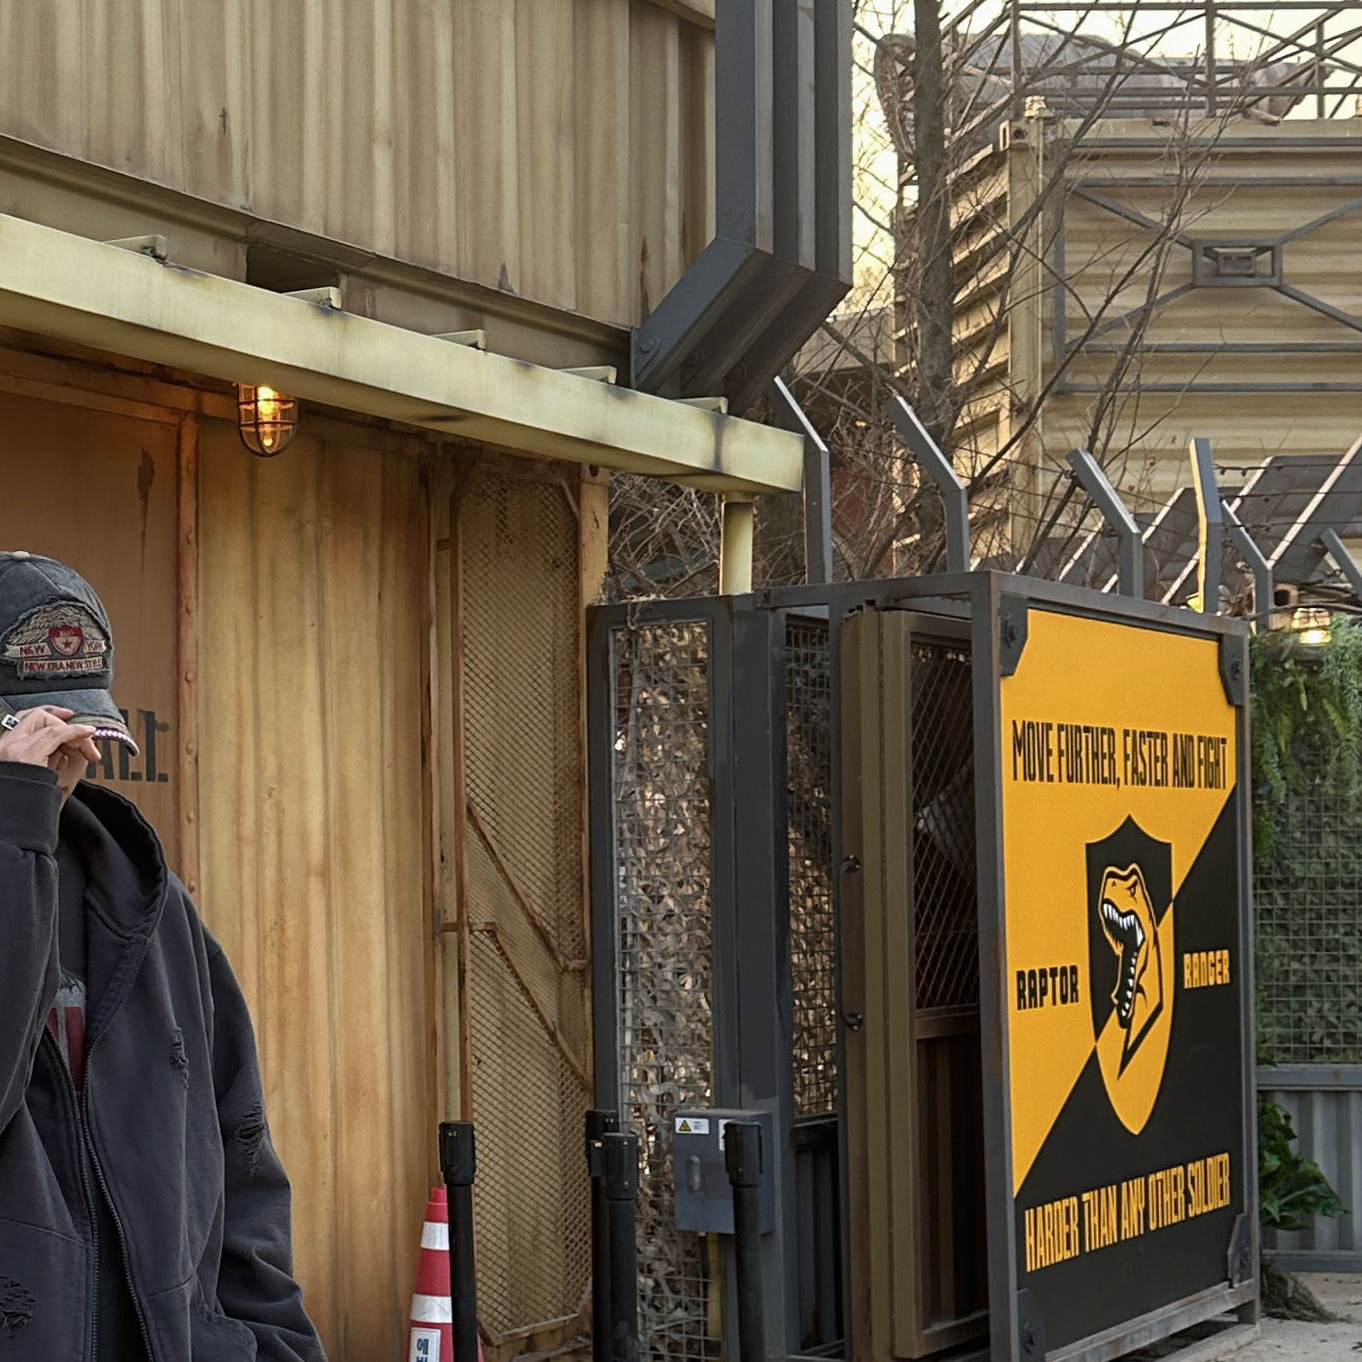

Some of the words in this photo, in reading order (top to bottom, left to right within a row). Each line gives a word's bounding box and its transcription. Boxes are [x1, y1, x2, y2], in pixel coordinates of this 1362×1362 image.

[19, 644, 45, 656] NEW
[24, 662, 46, 671] NEW
[66, 660, 84, 671] NEW
[1012, 719, 1055, 783] MOVE
[1057, 723, 1121, 792] FURTHER,
[1123, 728, 1169, 788] FASTER
[1172, 732, 1196, 789] AND
[1197, 735, 1228, 790] FIGHT
[1016, 964, 1079, 1011] RAPTOR
[1183, 949, 1231, 989] RANGER
[1024, 1195, 1080, 1273] HARDER
[1081, 1184, 1118, 1253] THAN
[1120, 1176, 1145, 1241] ANY
[1148, 1164, 1186, 1232] OTHER
[1187, 1151, 1231, 1219] SOLDIER
